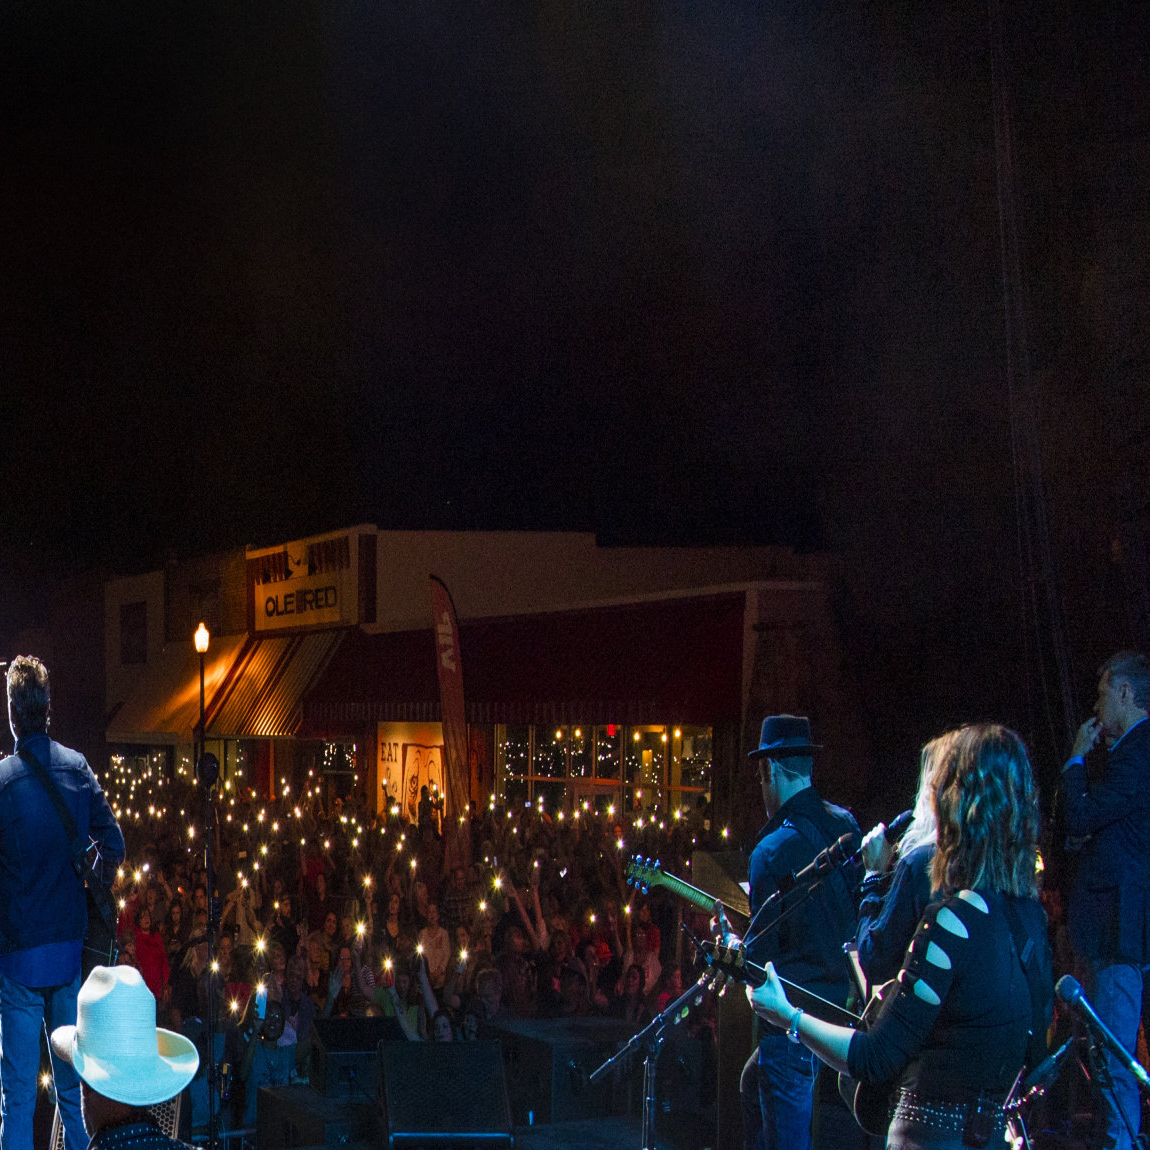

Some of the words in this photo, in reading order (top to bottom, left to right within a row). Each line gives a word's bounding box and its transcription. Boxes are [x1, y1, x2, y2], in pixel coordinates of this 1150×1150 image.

[265, 593, 295, 617] OLE
[304, 585, 337, 611] RED
[380, 742, 399, 763] EAT
